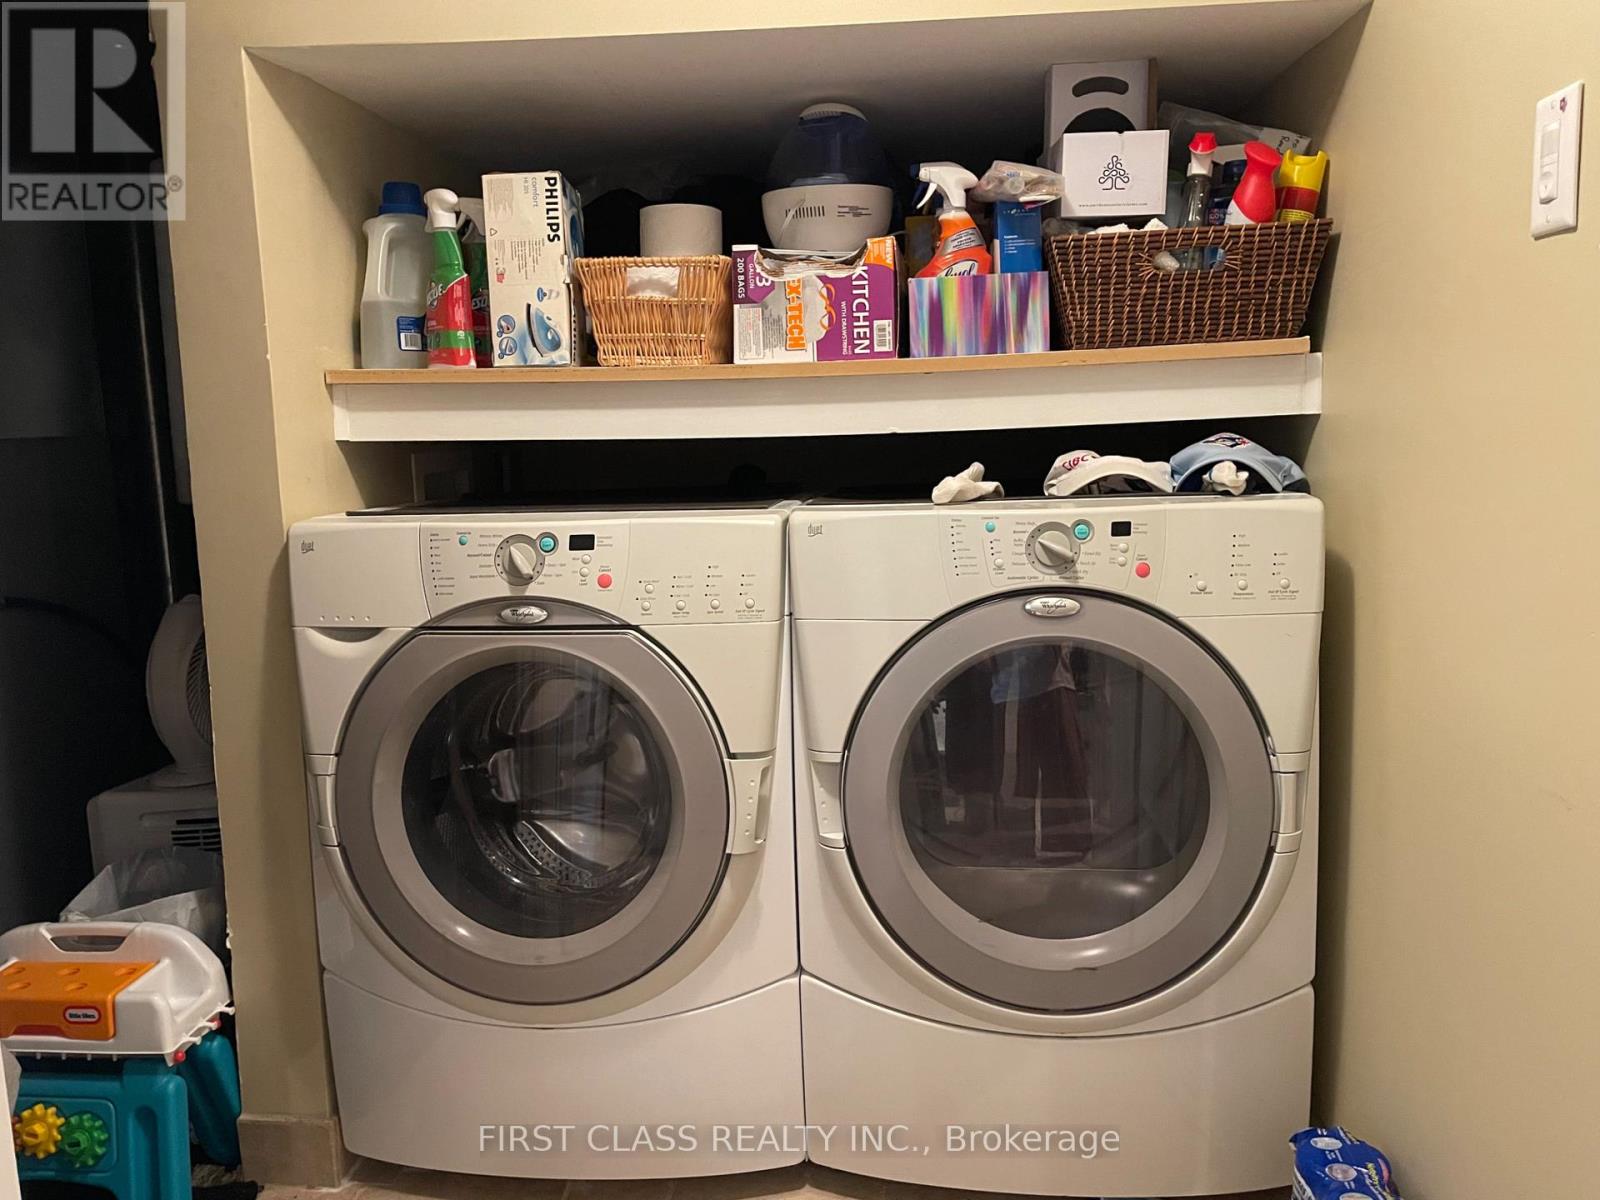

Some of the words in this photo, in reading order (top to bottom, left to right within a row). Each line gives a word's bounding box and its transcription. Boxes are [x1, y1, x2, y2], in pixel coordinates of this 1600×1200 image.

[531, 176, 539, 208] comfort
[544, 177, 560, 242] PHILIPS
[737, 257, 745, 273] 200
[737, 275, 745, 299] BAGS
[851, 265, 870, 353] KITCHEN
